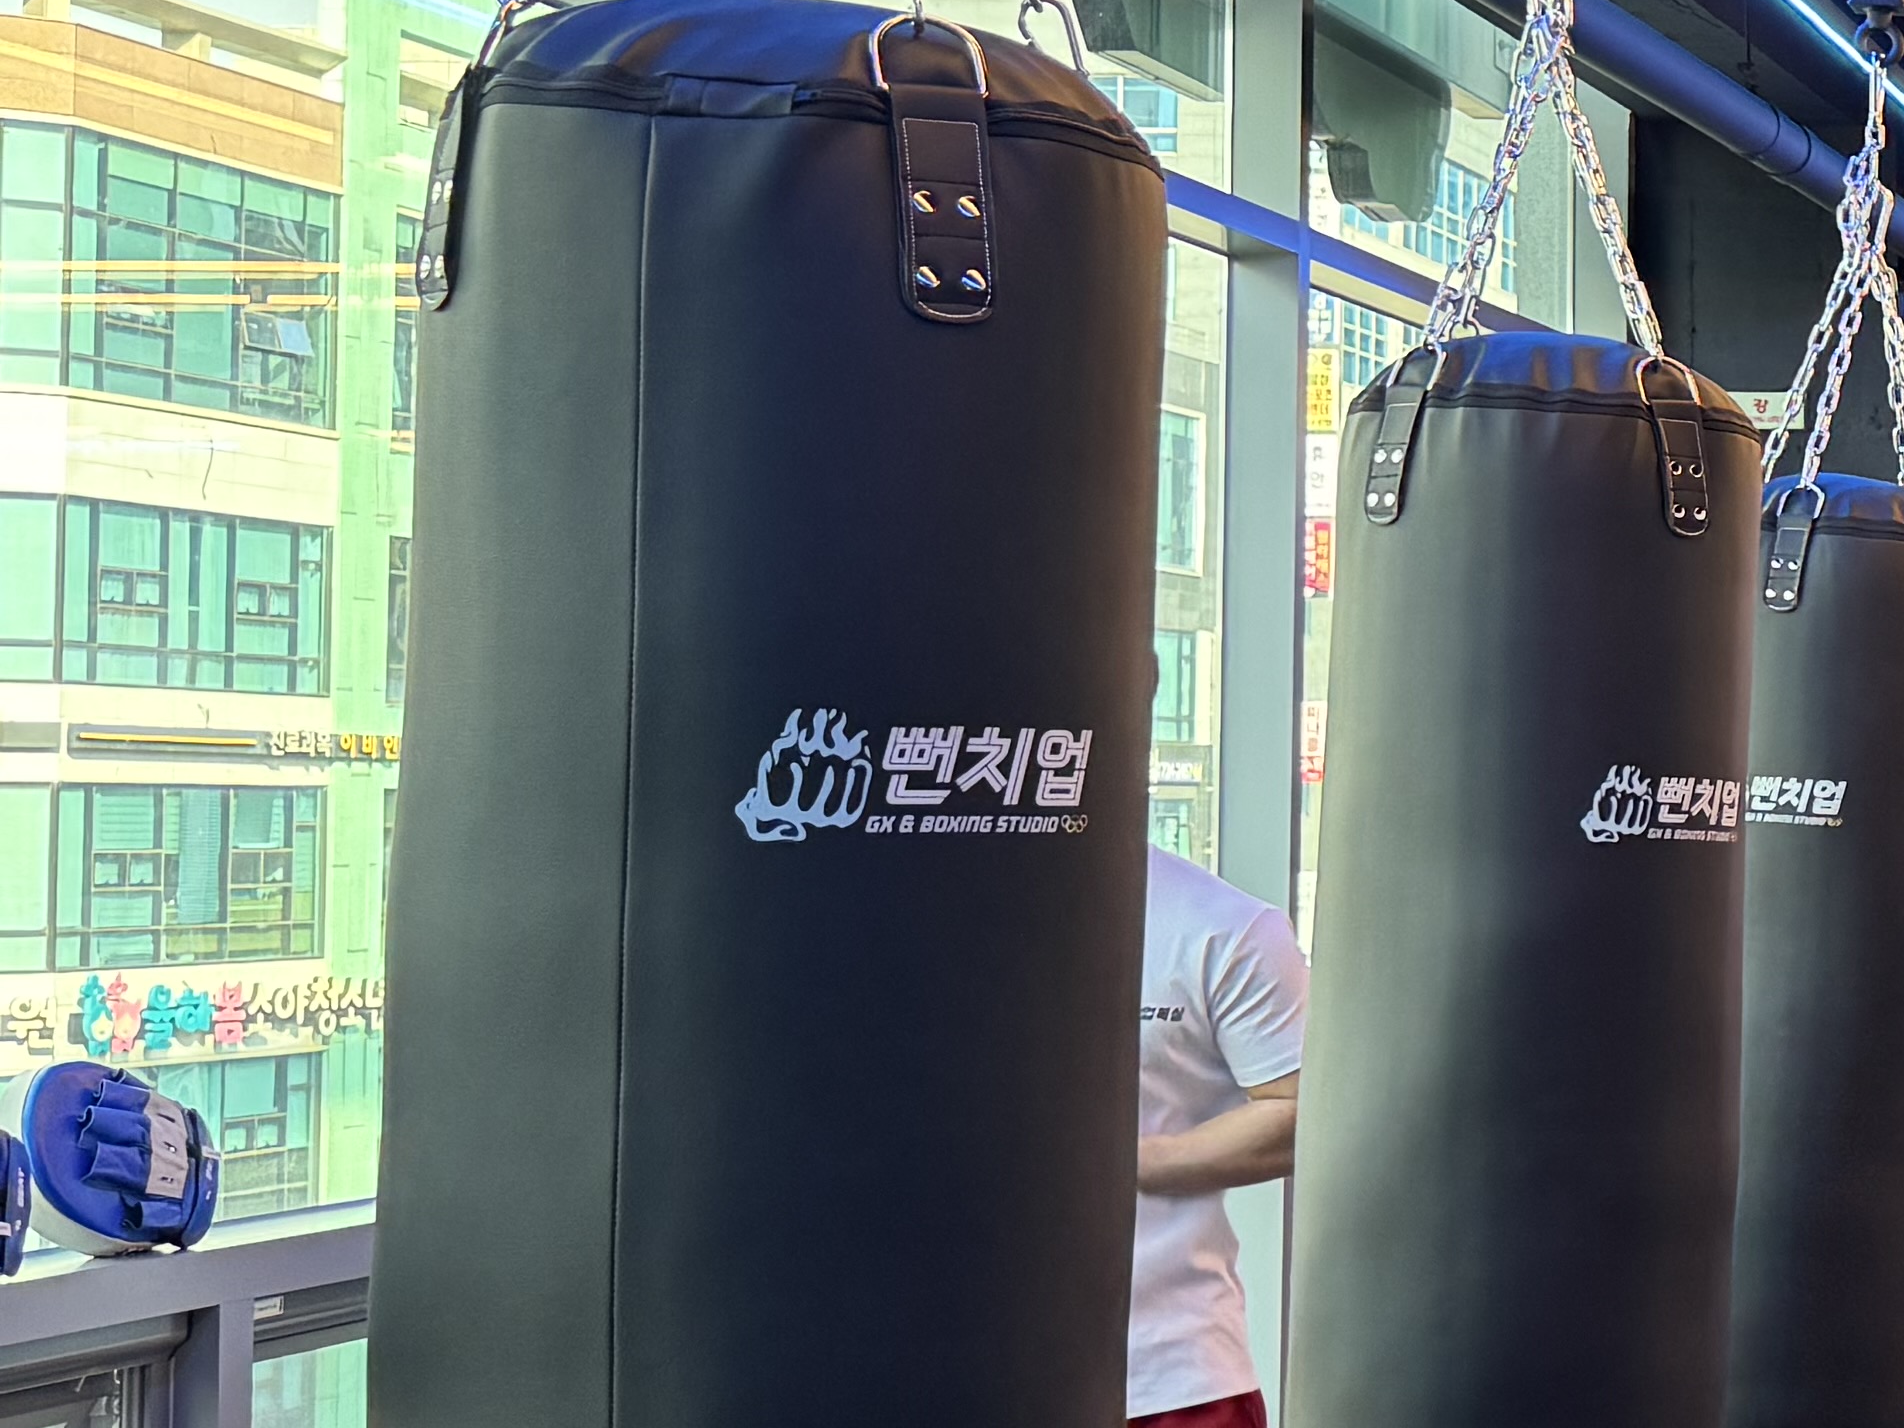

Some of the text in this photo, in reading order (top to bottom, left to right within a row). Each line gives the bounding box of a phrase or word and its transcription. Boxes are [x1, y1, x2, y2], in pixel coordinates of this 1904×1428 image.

[882, 725, 1094, 806] 뻔치업
[1656, 776, 1741, 827] 뻔치업
[1750, 775, 1847, 815] 뻔치업
[864, 814, 1059, 834] GX & BOXING STUDIO
